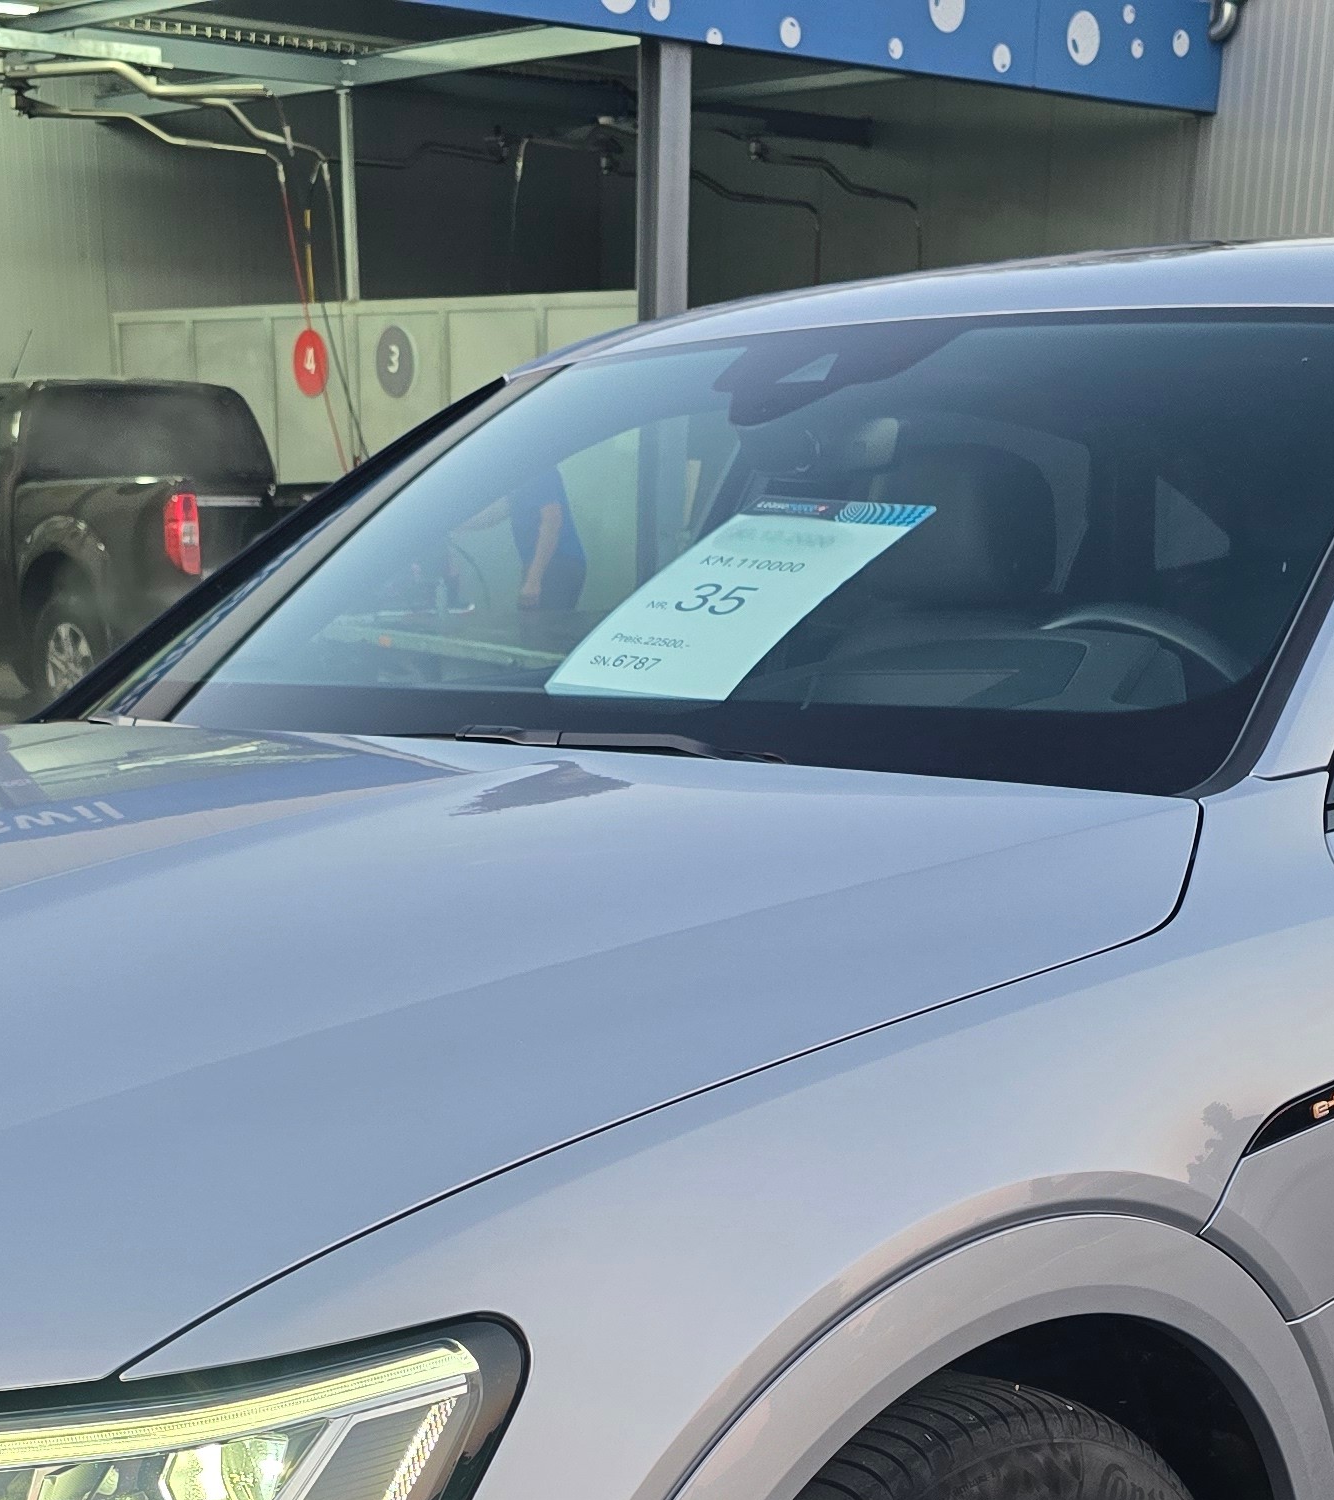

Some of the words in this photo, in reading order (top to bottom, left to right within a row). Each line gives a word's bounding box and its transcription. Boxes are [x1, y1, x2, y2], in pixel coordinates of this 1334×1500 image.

[303, 347, 316, 375] 4
[387, 344, 400, 373] 3
[699, 554, 806, 574] KM.110000
[674, 582, 760, 616] 35
[589, 653, 663, 672] SN.6787
